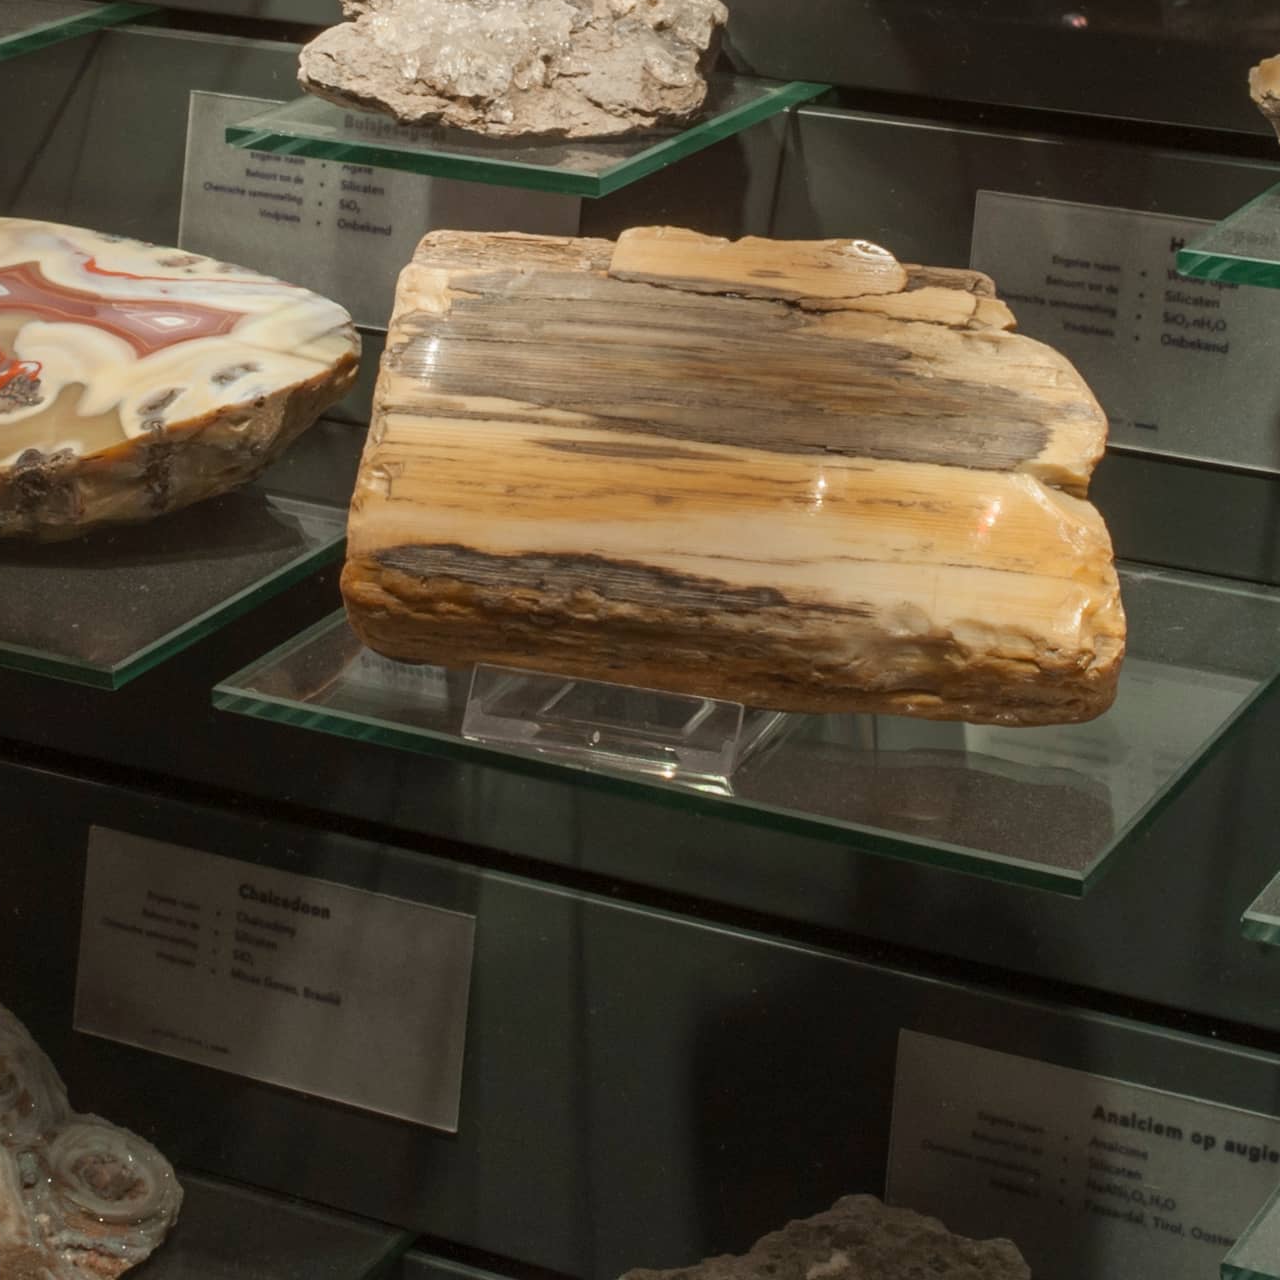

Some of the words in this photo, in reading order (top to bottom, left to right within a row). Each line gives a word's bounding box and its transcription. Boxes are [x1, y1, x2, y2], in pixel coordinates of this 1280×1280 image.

[341, 180, 384, 195] Silicaten
[337, 218, 391, 236] Onbekend
[1164, 290, 1220, 309] Silicaten
[1161, 333, 1229, 355] Onbekend
[238, 883, 330, 919] Chalcedoon
[1092, 1104, 1184, 1140] Analciem
[1191, 1131, 1217, 1151] op
